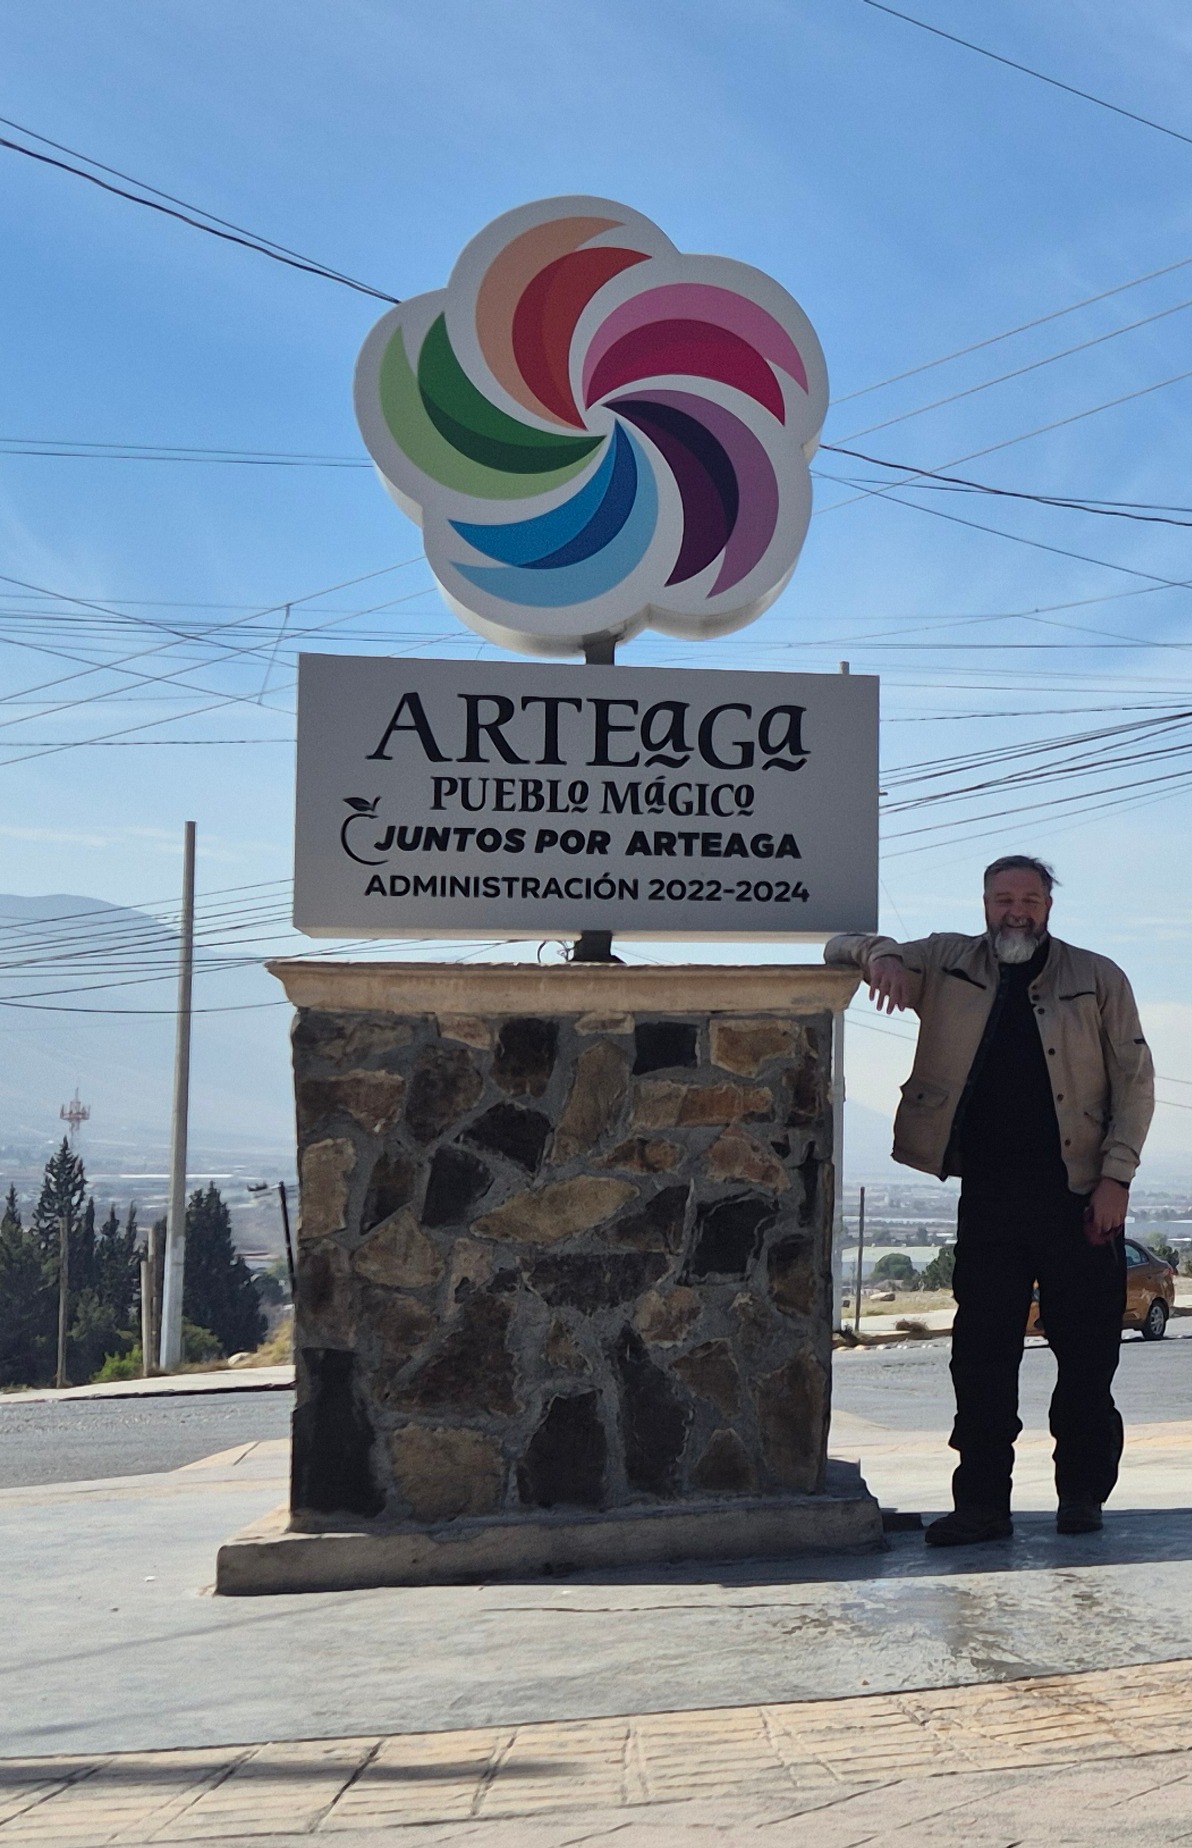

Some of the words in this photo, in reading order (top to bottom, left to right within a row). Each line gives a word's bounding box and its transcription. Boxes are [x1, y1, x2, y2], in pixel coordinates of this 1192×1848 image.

[374, 826, 526, 854] JUNTOS
[535, 829, 611, 855] POR
[625, 830, 802, 859] ARTEAGA
[364, 871, 638, 900] ADMINISTRACIÓN
[648, 878, 811, 903] 2022-2024
